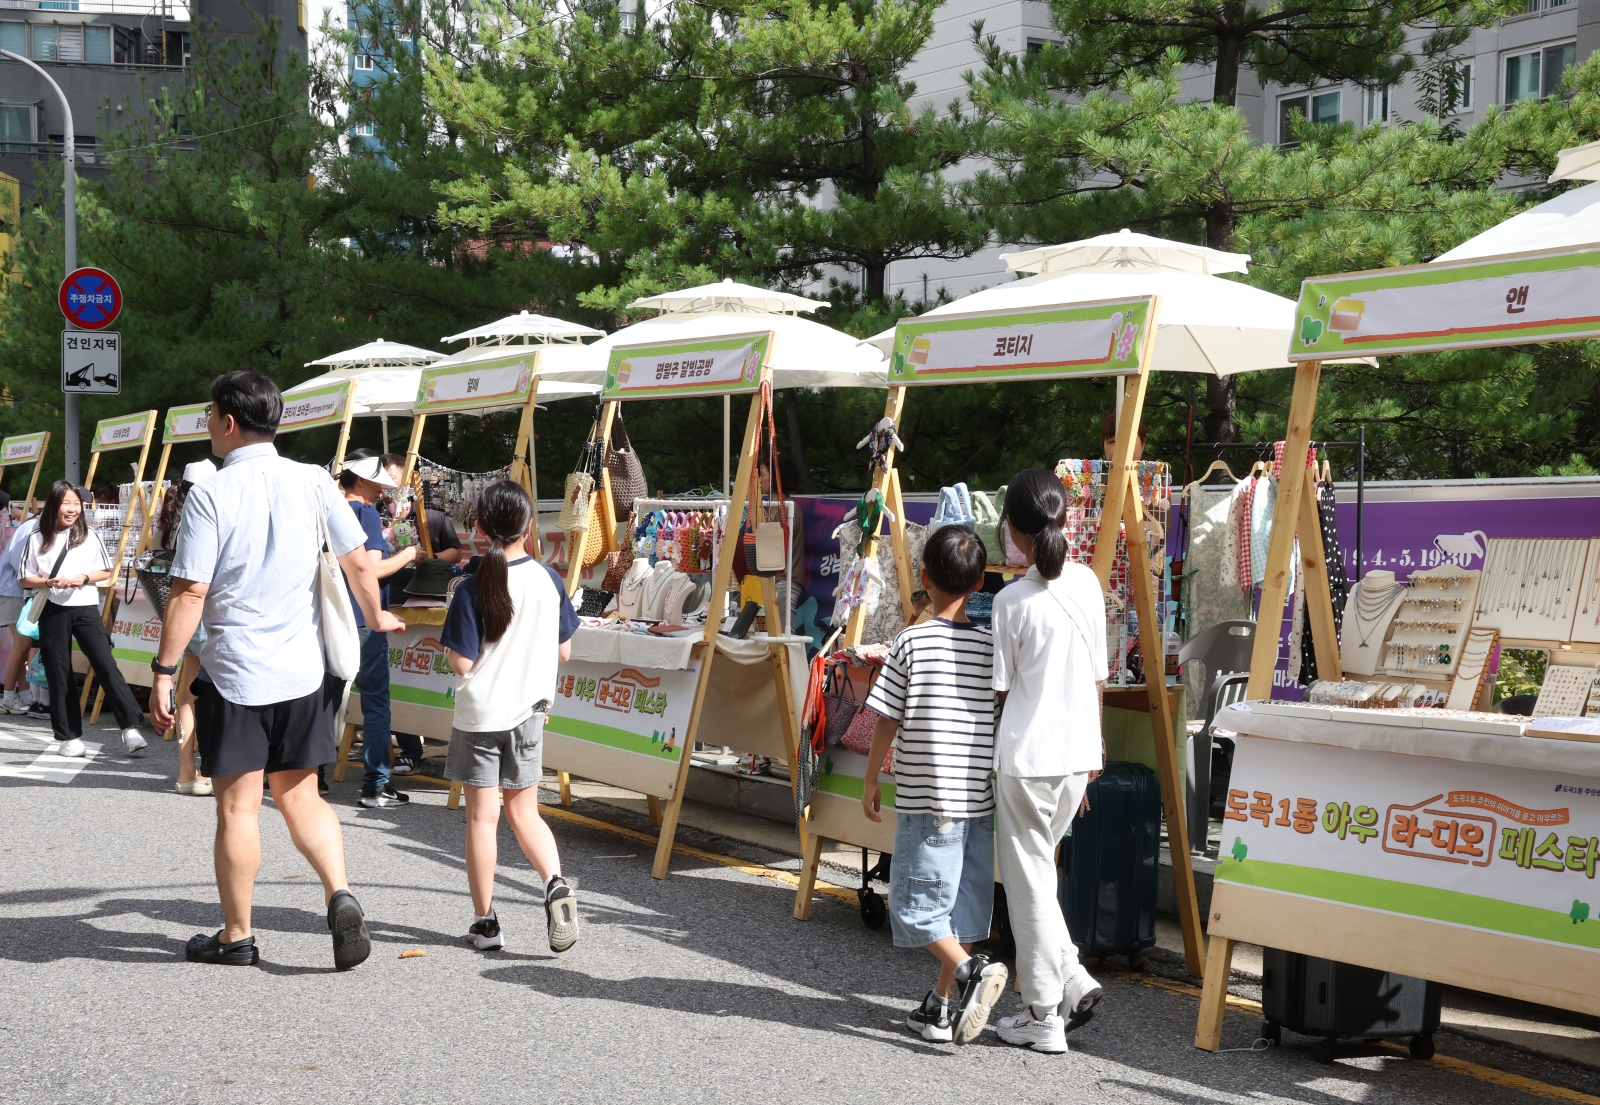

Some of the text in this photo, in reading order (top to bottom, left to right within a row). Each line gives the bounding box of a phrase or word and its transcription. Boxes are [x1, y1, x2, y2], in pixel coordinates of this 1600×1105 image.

[70, 294, 112, 304] 주정차금지
[1506, 285, 1529, 314] 앤
[66, 337, 116, 351] 견인지역
[993, 334, 1033, 356] 코티지
[655, 358, 714, 380] 명월주 달빛공방
[575, 677, 597, 702] 아우
[599, 683, 631, 707] 라-디오
[633, 689, 667, 718] 페스타
[1562, 786, 1583, 794] 도곡1동
[1453, 795, 1476, 804] 도곡1동
[1477, 796, 1497, 808] 주민의
[1497, 803, 1521, 819] 이야기를
[1537, 813, 1564, 822] 아우르는
[1224, 789, 1600, 879] 도곡1동 아우 라-디오 페스타
